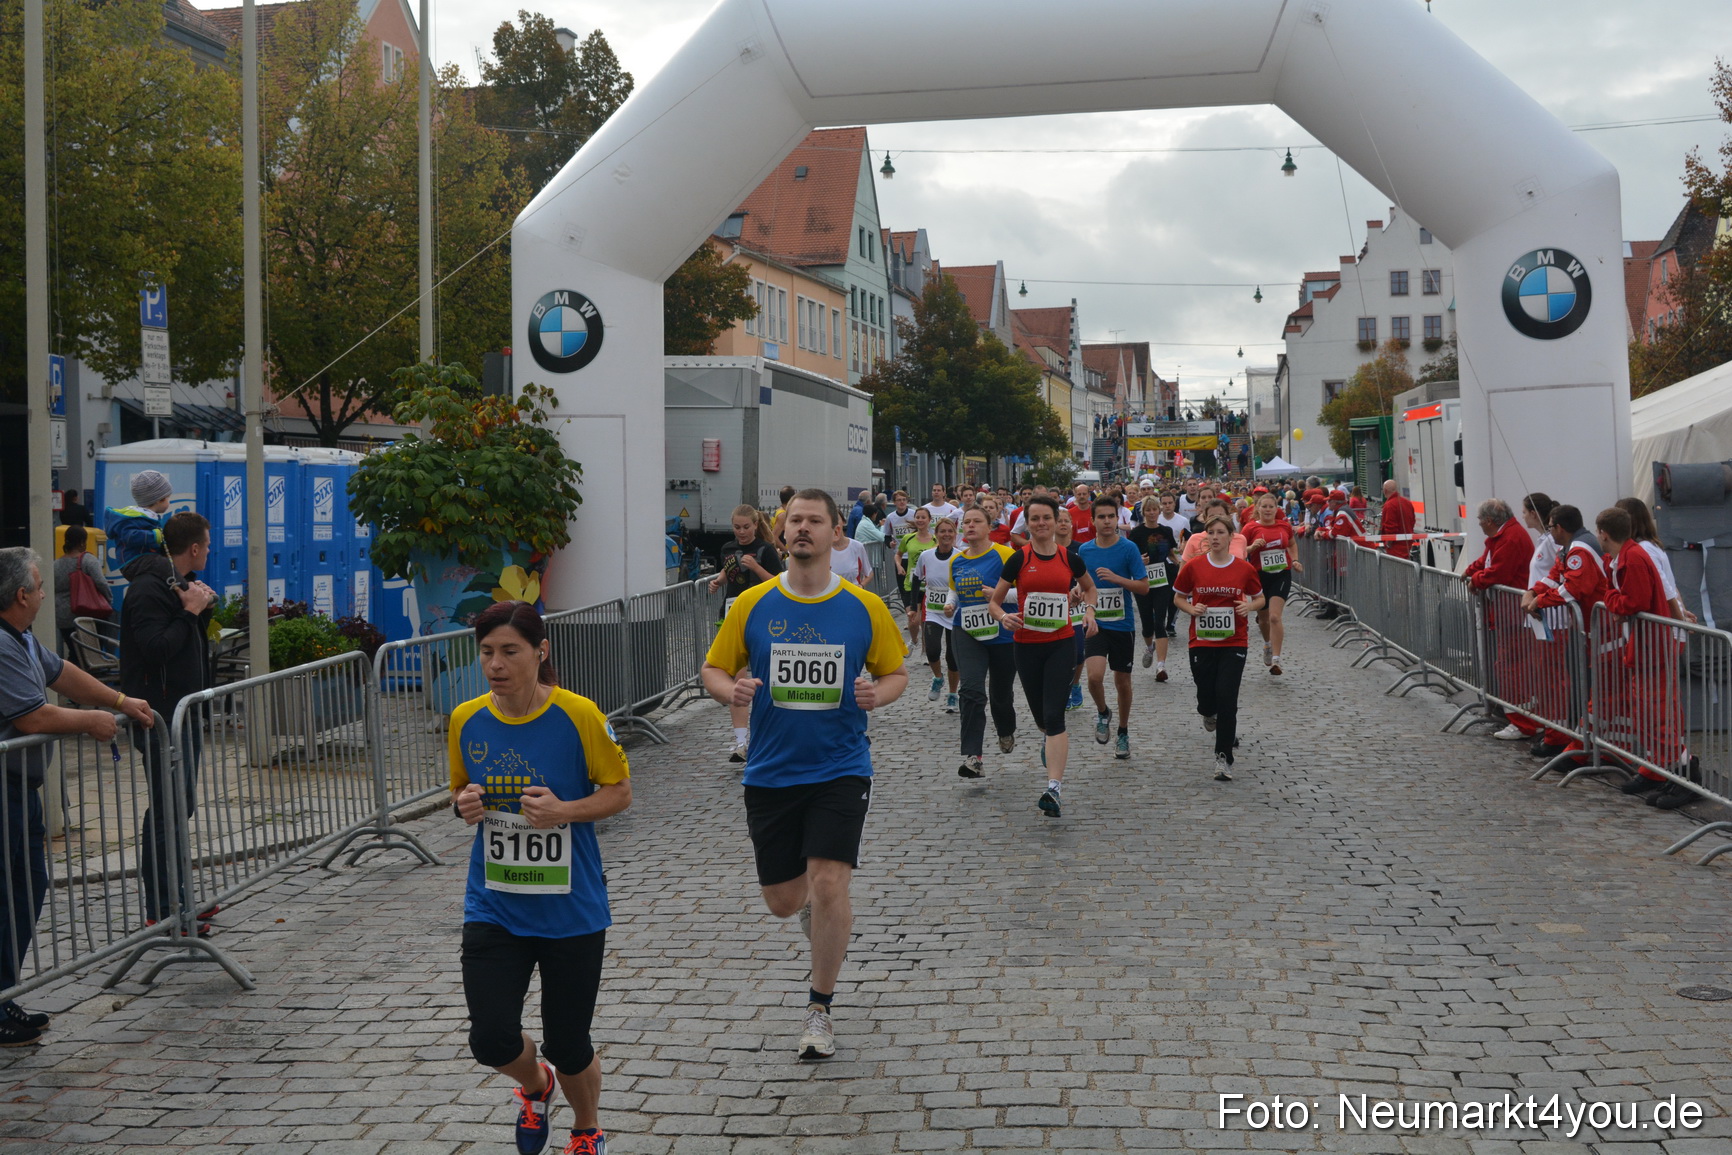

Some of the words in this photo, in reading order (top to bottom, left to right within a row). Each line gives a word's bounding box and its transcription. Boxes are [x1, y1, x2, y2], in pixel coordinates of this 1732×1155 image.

[1508, 250, 1585, 282] BMW
[532, 292, 598, 320] BMW
[87, 440, 95, 458] 3
[1156, 439, 1188, 448] START
[1263, 554, 1285, 565] 5106
[1028, 602, 1063, 618] 5011
[965, 612, 995, 628] 5010
[1199, 616, 1231, 629] 5050
[778, 660, 837, 685] 5060
[788, 690, 824, 700] Michael
[485, 816, 509, 829] PARTL
[490, 831, 562, 862] 5160
[504, 869, 544, 882] Kerstin
